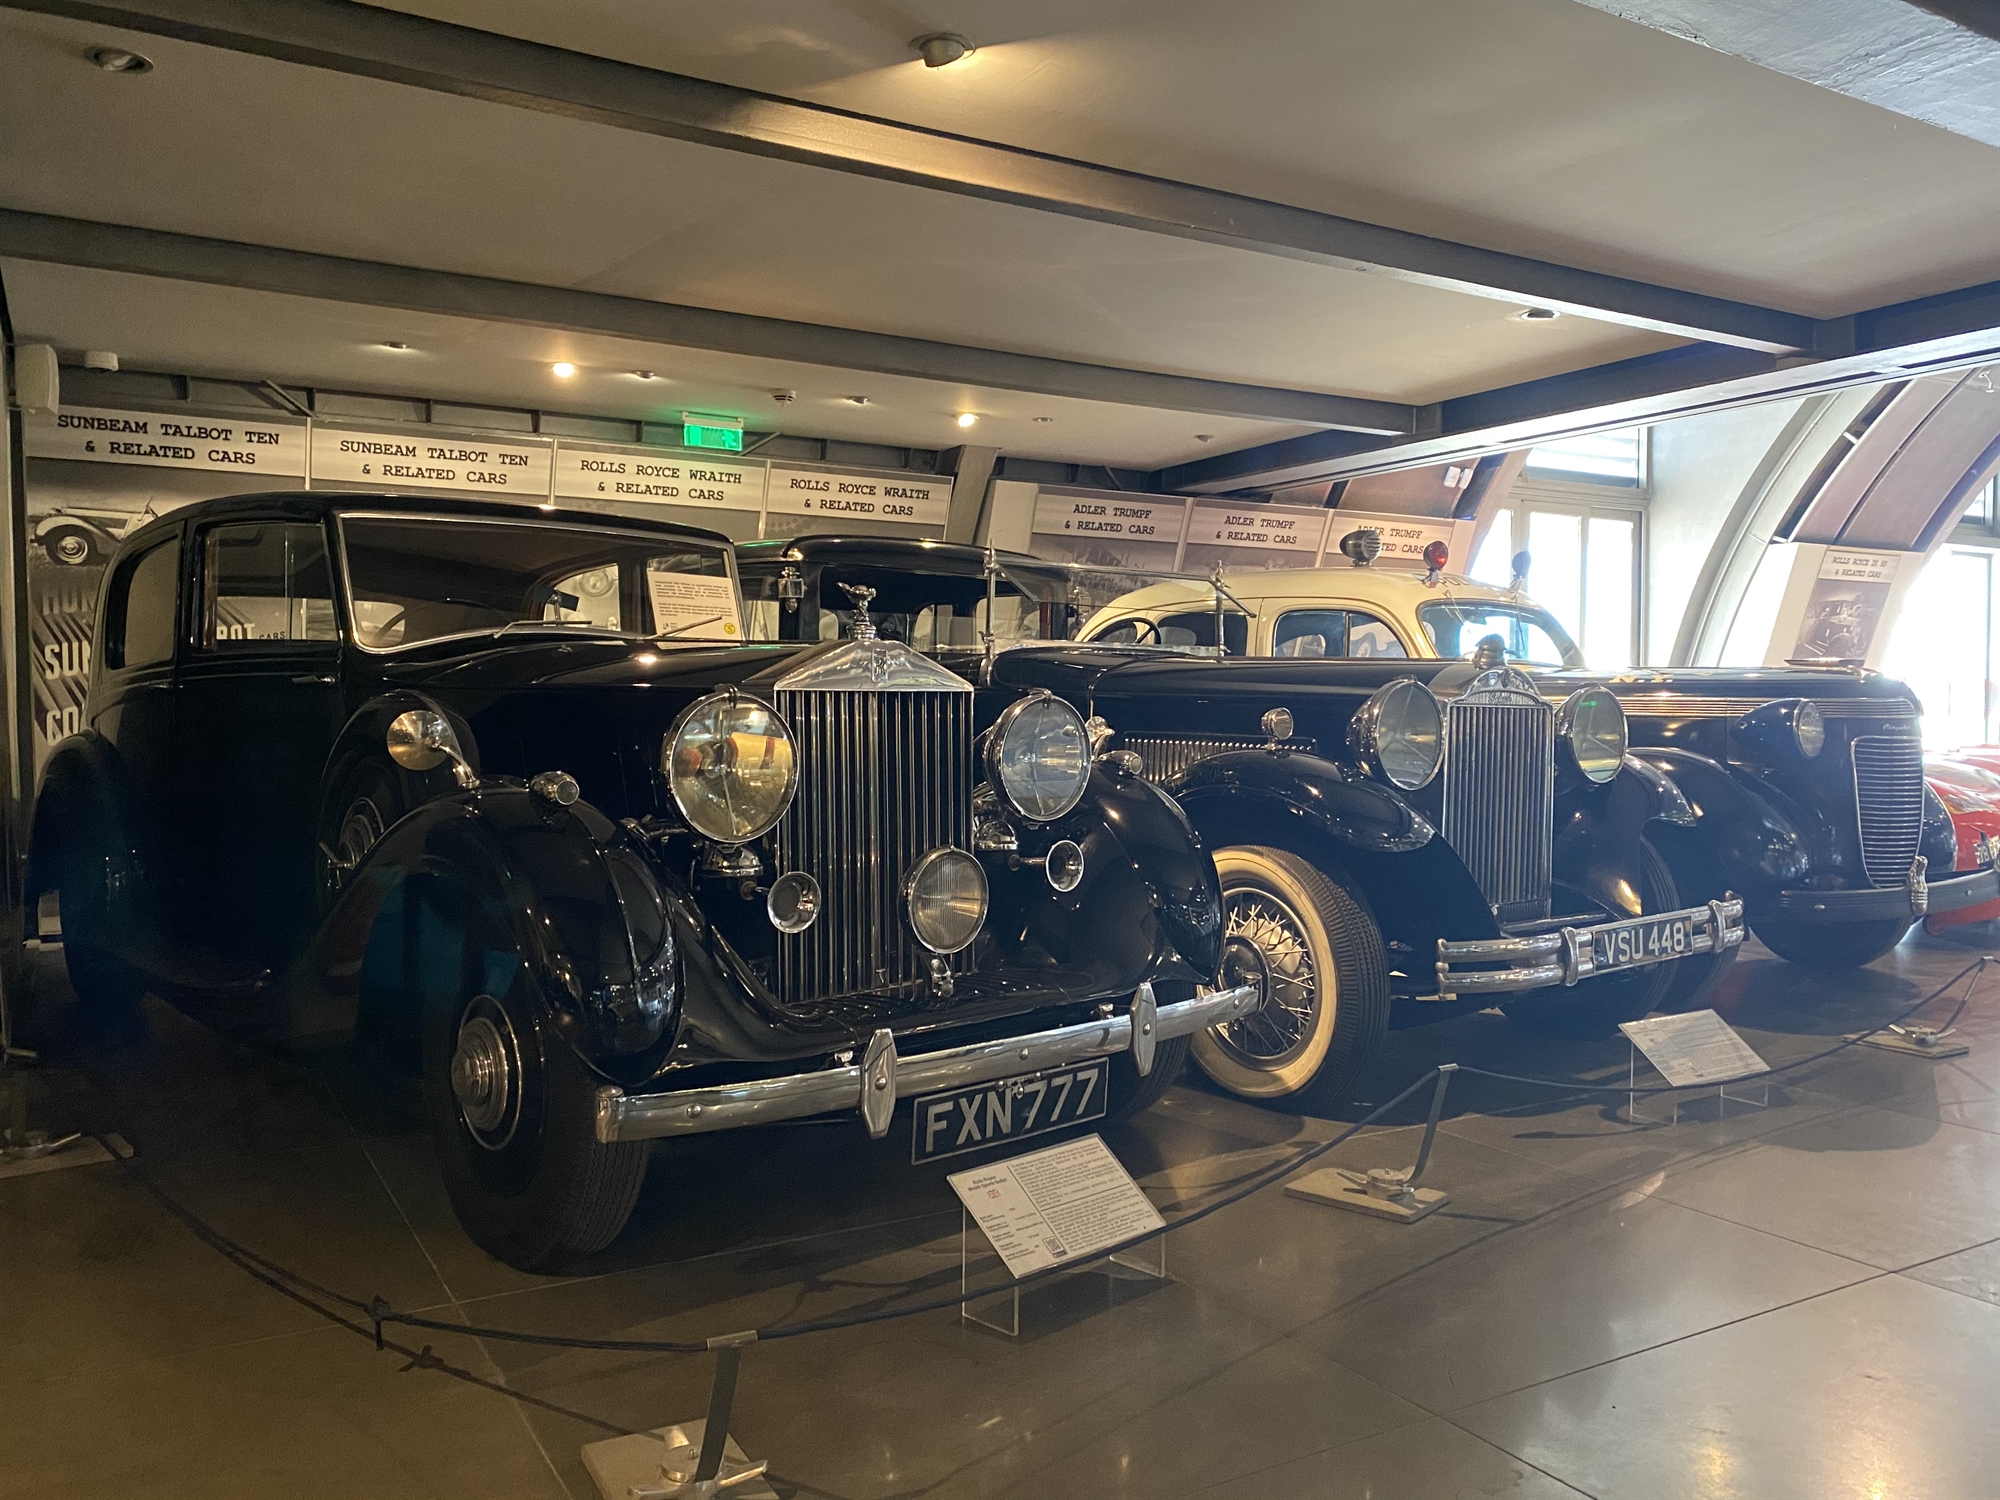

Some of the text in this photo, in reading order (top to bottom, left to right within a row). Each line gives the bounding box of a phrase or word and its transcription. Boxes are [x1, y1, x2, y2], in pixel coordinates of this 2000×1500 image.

[57, 415, 280, 445] SUNBEAM TALBOT TEN
[85, 440, 256, 464] & RELATED CARS
[340, 440, 529, 466] SUNBEAM TALBOT TEN
[362, 464, 507, 485] & RELATED CARS
[580, 460, 742, 484] ROLLS ROYCE WRAITH
[598, 482, 724, 500] & RELATED CARS
[790, 478, 930, 500] ROLLS ROYCE WRAITH
[804, 498, 913, 516] & RELATED CARS
[1073, 504, 1152, 519] ADLER TRUMPF
[1064, 520, 1155, 535] & RELATED CARS
[1224, 516, 1295, 529] ADLER TRUMPF
[1216, 531, 1297, 544] & RELATED CARS
[1390, 528, 1423, 539] TRUMPF
[1401, 544, 1424, 553] CARS
[1604, 921, 1685, 964] VSU 448
[926, 1068, 1099, 1153] FXN 777
